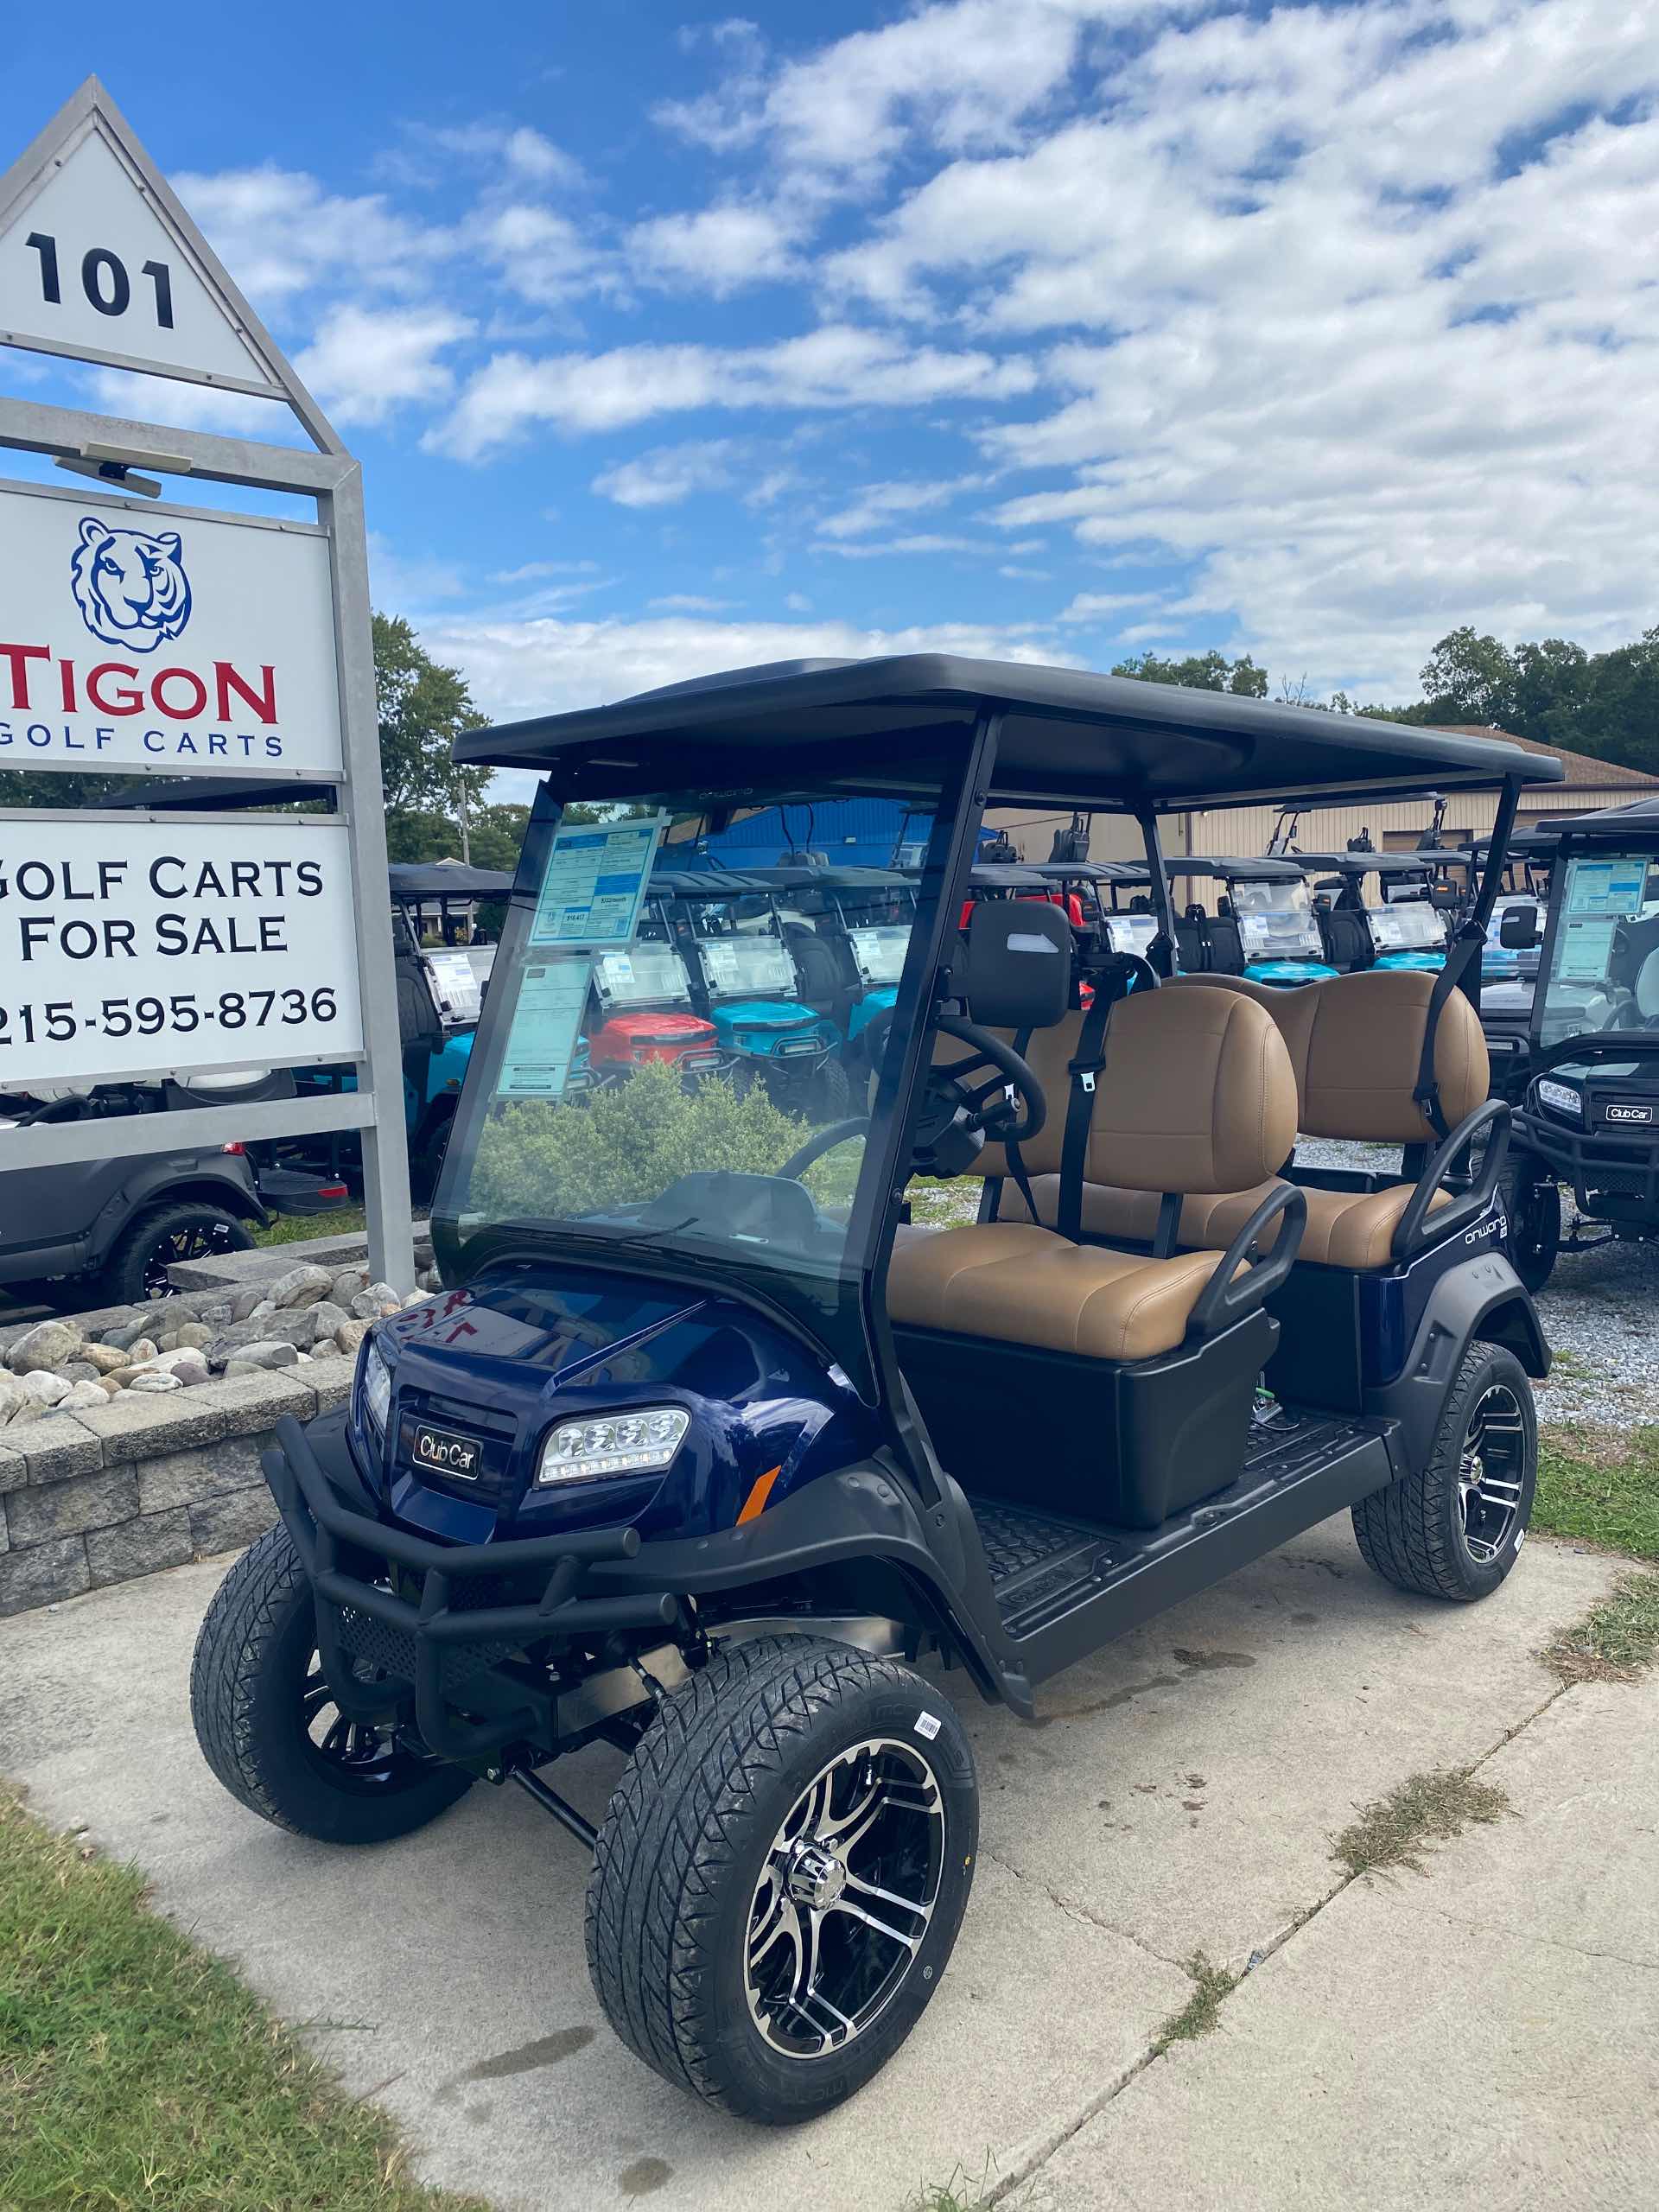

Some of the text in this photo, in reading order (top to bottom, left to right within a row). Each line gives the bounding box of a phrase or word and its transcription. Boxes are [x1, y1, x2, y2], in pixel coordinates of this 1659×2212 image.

[25, 232, 175, 329] 101
[0, 643, 278, 724] TIGON
[143, 731, 283, 757] CARTS
[0, 856, 323, 901] OLF CARTS
[18, 914, 289, 961] FOR SALE
[1630, 1109, 1648, 1119] Car
[420, 1435, 474, 1469] Club Car
